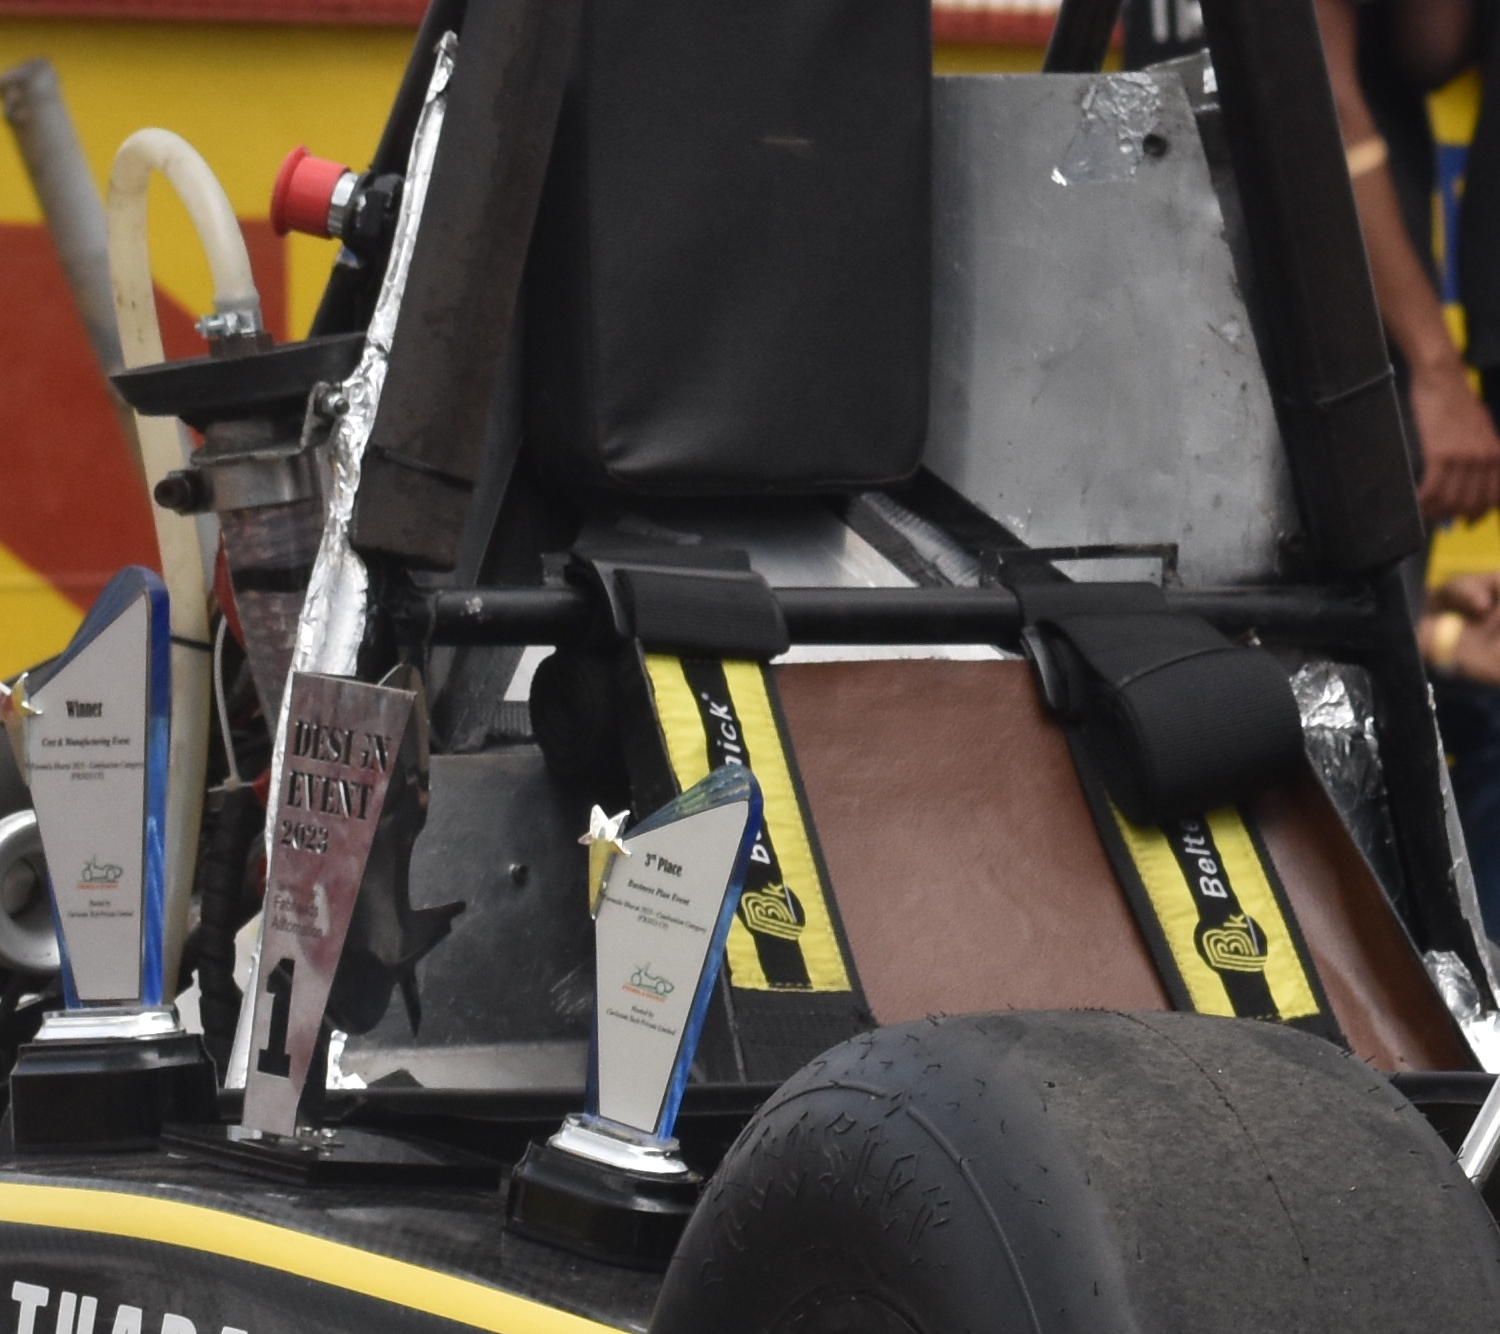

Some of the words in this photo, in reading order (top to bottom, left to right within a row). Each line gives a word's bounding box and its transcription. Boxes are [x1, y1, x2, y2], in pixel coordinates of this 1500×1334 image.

[292, 720, 391, 774] DESIGN
[286, 769, 375, 821] EVENT
[280, 818, 330, 855] 2023
